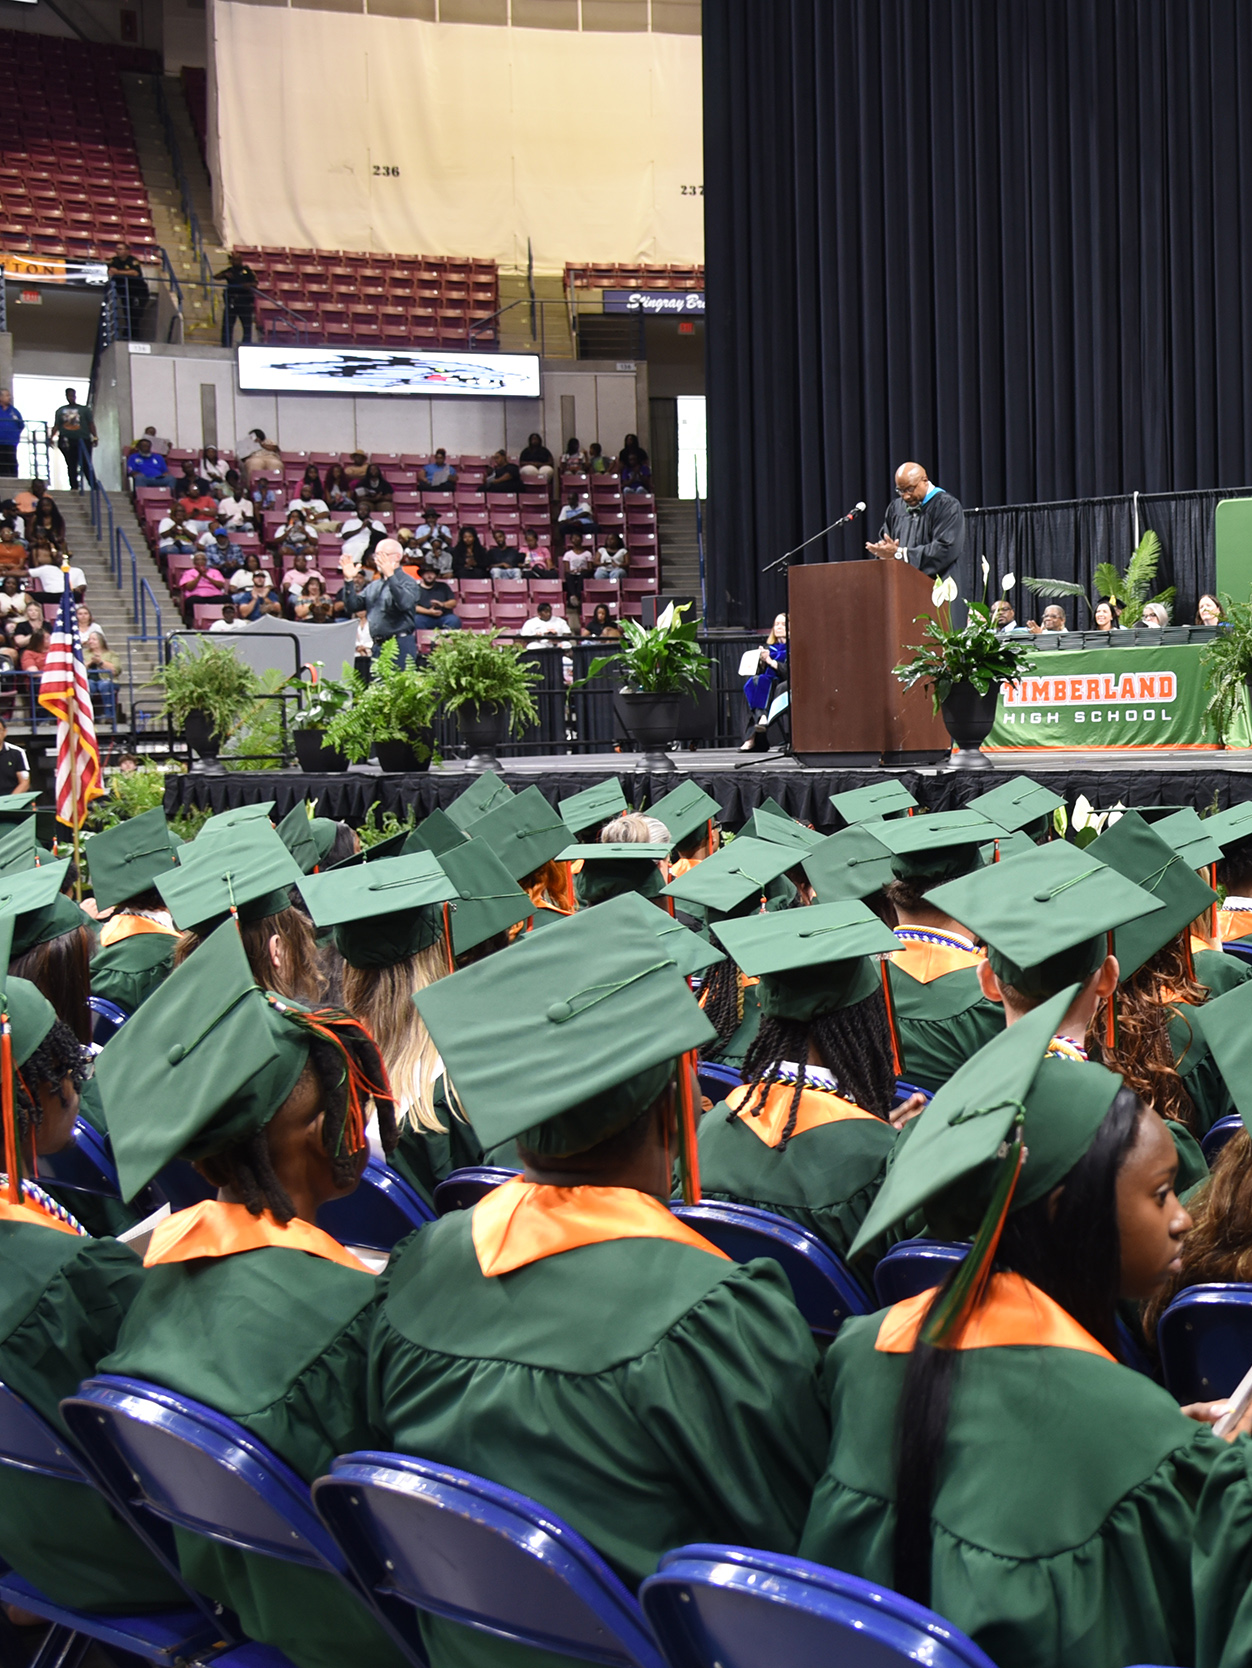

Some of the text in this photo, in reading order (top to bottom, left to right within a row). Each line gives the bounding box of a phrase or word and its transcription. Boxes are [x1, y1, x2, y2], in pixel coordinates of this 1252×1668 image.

[372, 165, 400, 177] 236
[1, 262, 55, 275] TON
[626, 293, 684, 312] Stingray
[1002, 673, 1175, 704] TIMBERLAND
[1003, 709, 1172, 724] HIGH SCHOOL
